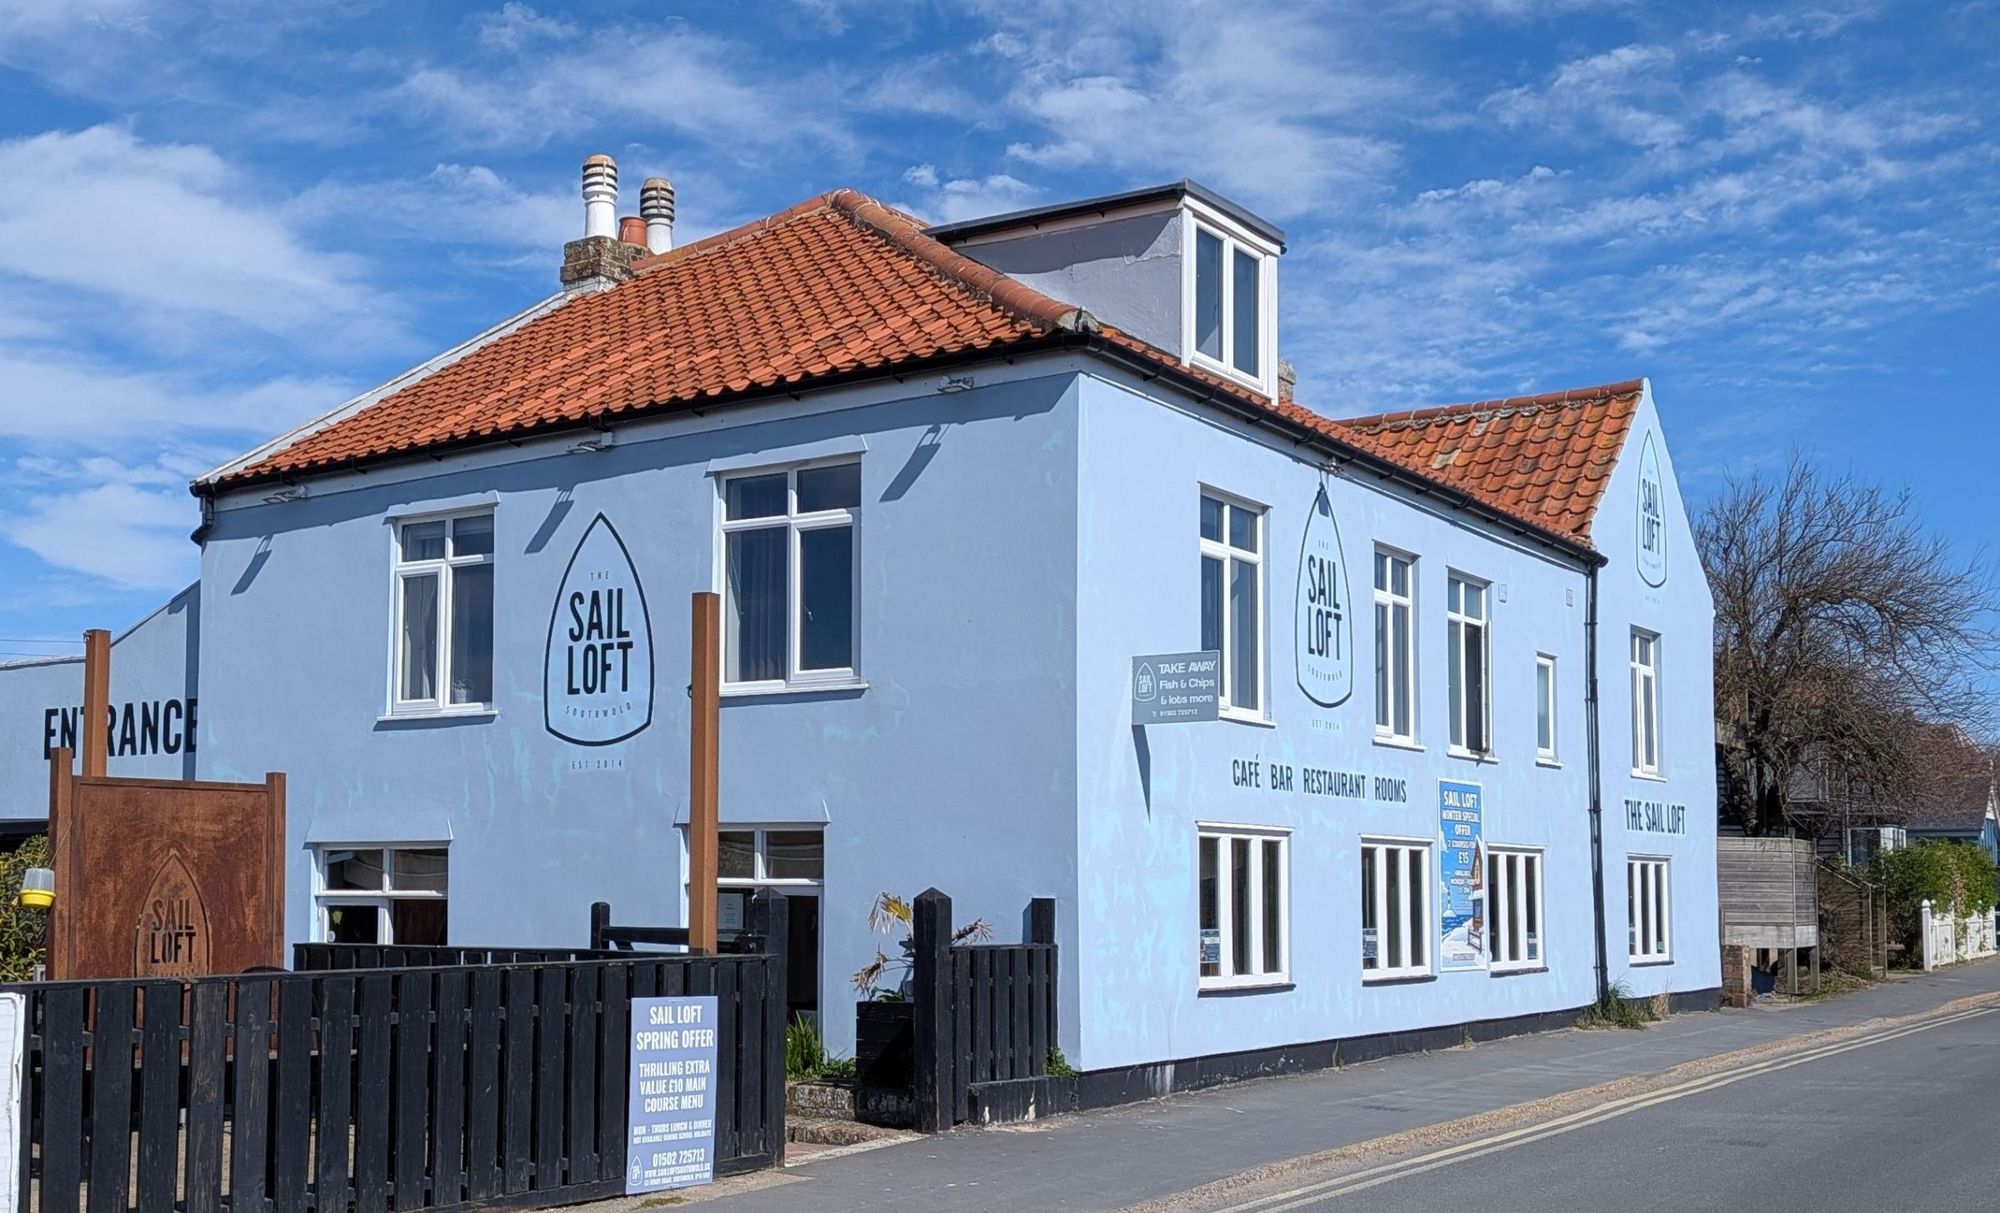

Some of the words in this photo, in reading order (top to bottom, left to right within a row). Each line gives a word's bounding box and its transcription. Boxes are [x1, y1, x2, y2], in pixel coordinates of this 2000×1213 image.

[1642, 478, 1660, 519] SAIL
[1642, 514, 1660, 555] LOFT
[1308, 554, 1340, 610] SAIL
[568, 588, 630, 642] SAIL
[1308, 605, 1342, 660] LOFT
[567, 641, 634, 695] LOFT
[1158, 662, 1186, 674] TAKE
[1188, 660, 1216, 672] AWAY
[1138, 683, 1152, 693] LOFT
[1160, 680, 1178, 689] Fish
[1180, 680, 1186, 688] &
[1188, 678, 1214, 689] Chips
[1161, 696, 1167, 705] &
[1169, 696, 1187, 704] lots
[1189, 695, 1213, 704] more
[566, 702, 632, 718] SOUTHWOLD
[572, 760, 588, 770] EST
[596, 760, 622, 768] 2014
[1232, 754, 1261, 788] CAFÉ
[1270, 764, 1293, 792] BAR
[1303, 768, 1366, 799] RESTAURANT
[1374, 776, 1407, 803] ROOMS
[1444, 790, 1460, 807] SAIL
[1462, 793, 1478, 809] LOFT
[1624, 800, 1643, 831] THE
[1645, 802, 1665, 832] SAIL
[1667, 804, 1685, 834] LOFT
[1455, 824, 1471, 836] OFFER
[152, 898, 194, 931] SAIL
[150, 931, 196, 964] LOFT
[650, 1006, 674, 1024] SAIL
[677, 1005, 702, 1024] LOFT
[636, 1030, 679, 1050] SPRING
[682, 1029, 714, 1048] OFFER
[639, 1061, 683, 1078] THRILLING
[685, 1059, 710, 1074] EXTRA
[640, 1080, 667, 1095] VALUE
[669, 1078, 683, 1093] £10
[686, 1077, 706, 1092] MAIN
[645, 1096, 679, 1112] COURSE
[681, 1094, 703, 1110] MENU
[633, 1125, 646, 1135] MON
[652, 1123, 669, 1134] THURS
[670, 1121, 688, 1132] LUNCH
[693, 1120, 712, 1129] DINNER
[652, 1151, 677, 1167] 01502
[678, 1148, 705, 1164] 725713
